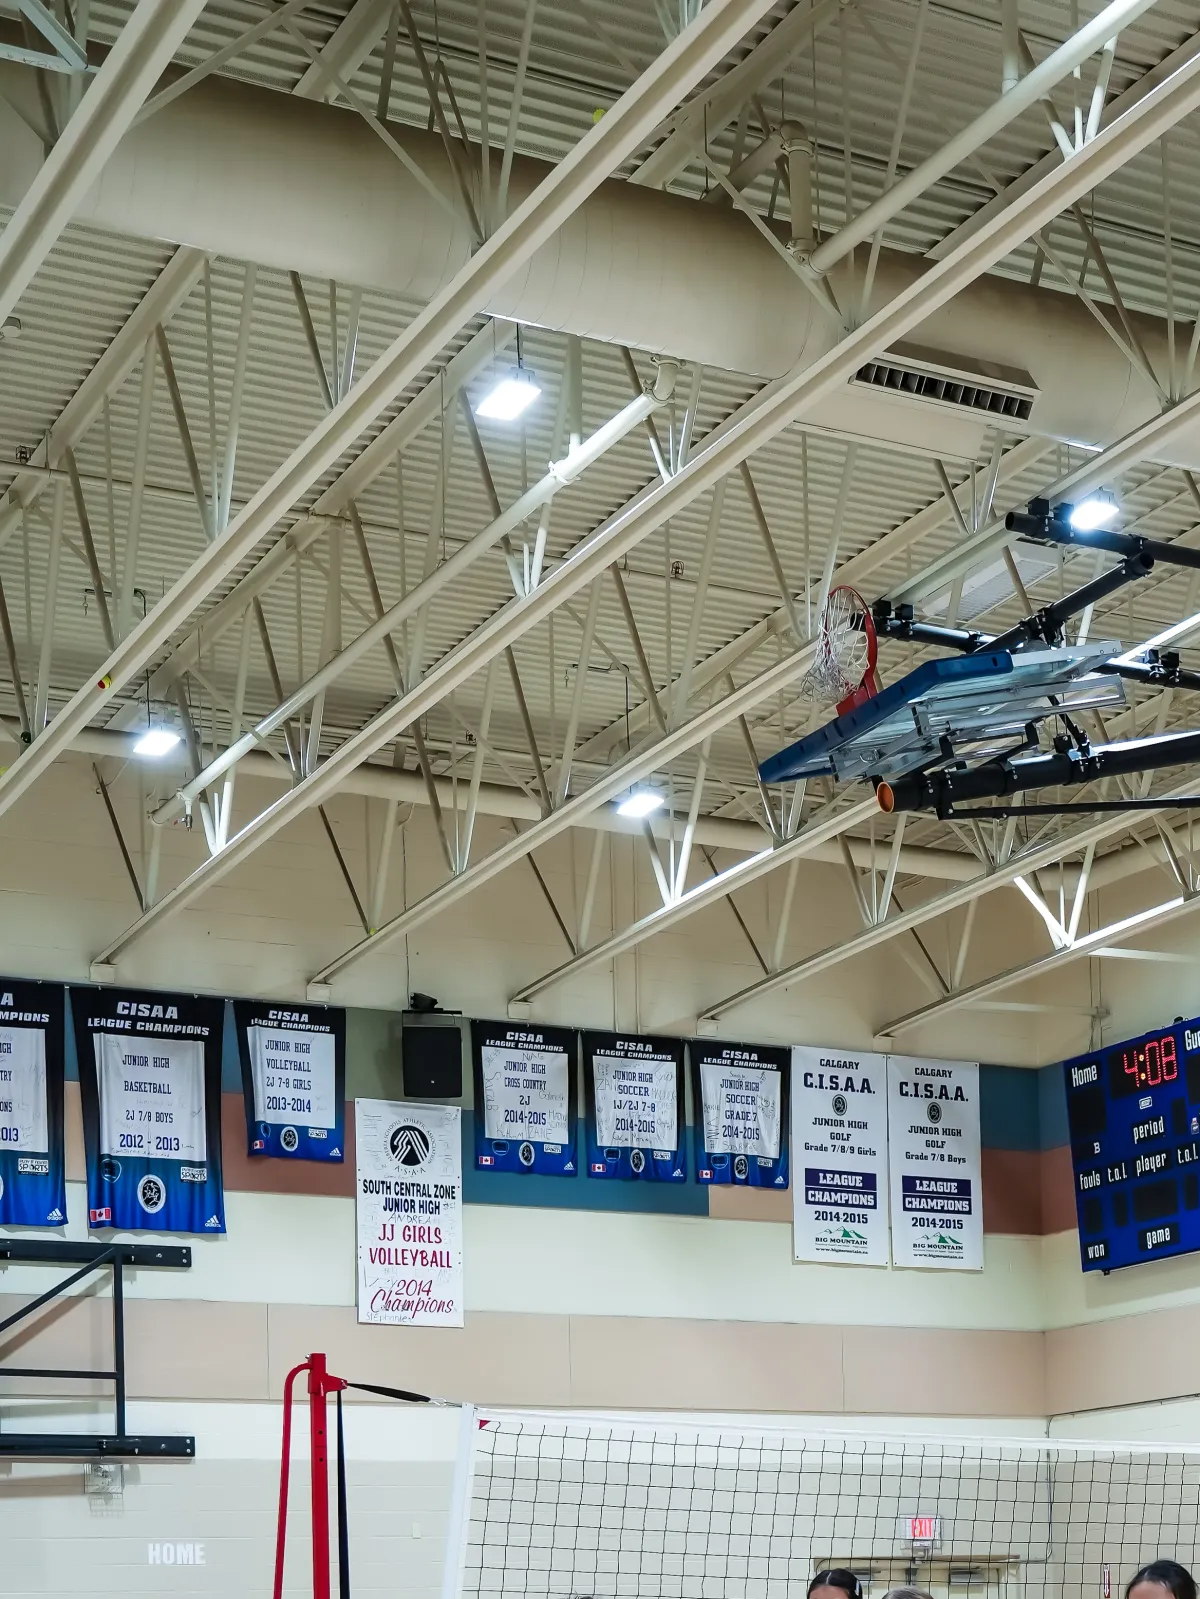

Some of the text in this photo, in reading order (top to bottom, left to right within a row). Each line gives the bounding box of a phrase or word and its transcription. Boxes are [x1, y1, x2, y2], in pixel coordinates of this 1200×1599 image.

[116, 1002, 178, 1020] CISAA
[88, 1018, 209, 1035] LEAGUE CHAMPIONS
[265, 1039, 311, 1054] JUNIOR HIGH
[616, 1041, 653, 1052] CISAA
[266, 1057, 311, 1072] VOLLEYBALL
[1124, 1036, 1177, 1087] 4:08
[504, 1077, 546, 1091] CROSS COUNTRY
[1072, 1065, 1098, 1087] Home
[124, 1080, 171, 1095] BASKETBALL
[618, 1084, 650, 1098] SOCCER
[266, 1096, 312, 1112] 2013-2014
[726, 1094, 756, 1106] SOCCER
[125, 1109, 173, 1123] 2J 7/8 BOYS
[504, 1109, 547, 1126] 2014-2015
[725, 1109, 757, 1122] GRADE 7
[812, 1117, 868, 1130] JUNIOR HIGH
[830, 1131, 852, 1142] GOLF
[1133, 1116, 1164, 1144] period
[1080, 1171, 1100, 1190] fouls
[1136, 1152, 1166, 1176] player
[363, 1180, 456, 1199] SOUTH CENTRAL ZONE
[808, 1188, 874, 1206] CHAMPIONS
[383, 1198, 440, 1214] JUNIOR HIGH
[814, 1210, 868, 1224] 2014-2015
[378, 1223, 442, 1243] JJ GIRLS
[1147, 1228, 1170, 1249] game
[369, 1248, 452, 1268] VOLLEYBALL
[1088, 1242, 1104, 1258] won
[395, 1280, 432, 1296] 2014
[371, 1289, 453, 1318] Champions
[912, 1519, 932, 1537] EXIT
[148, 1543, 205, 1565] HOME
